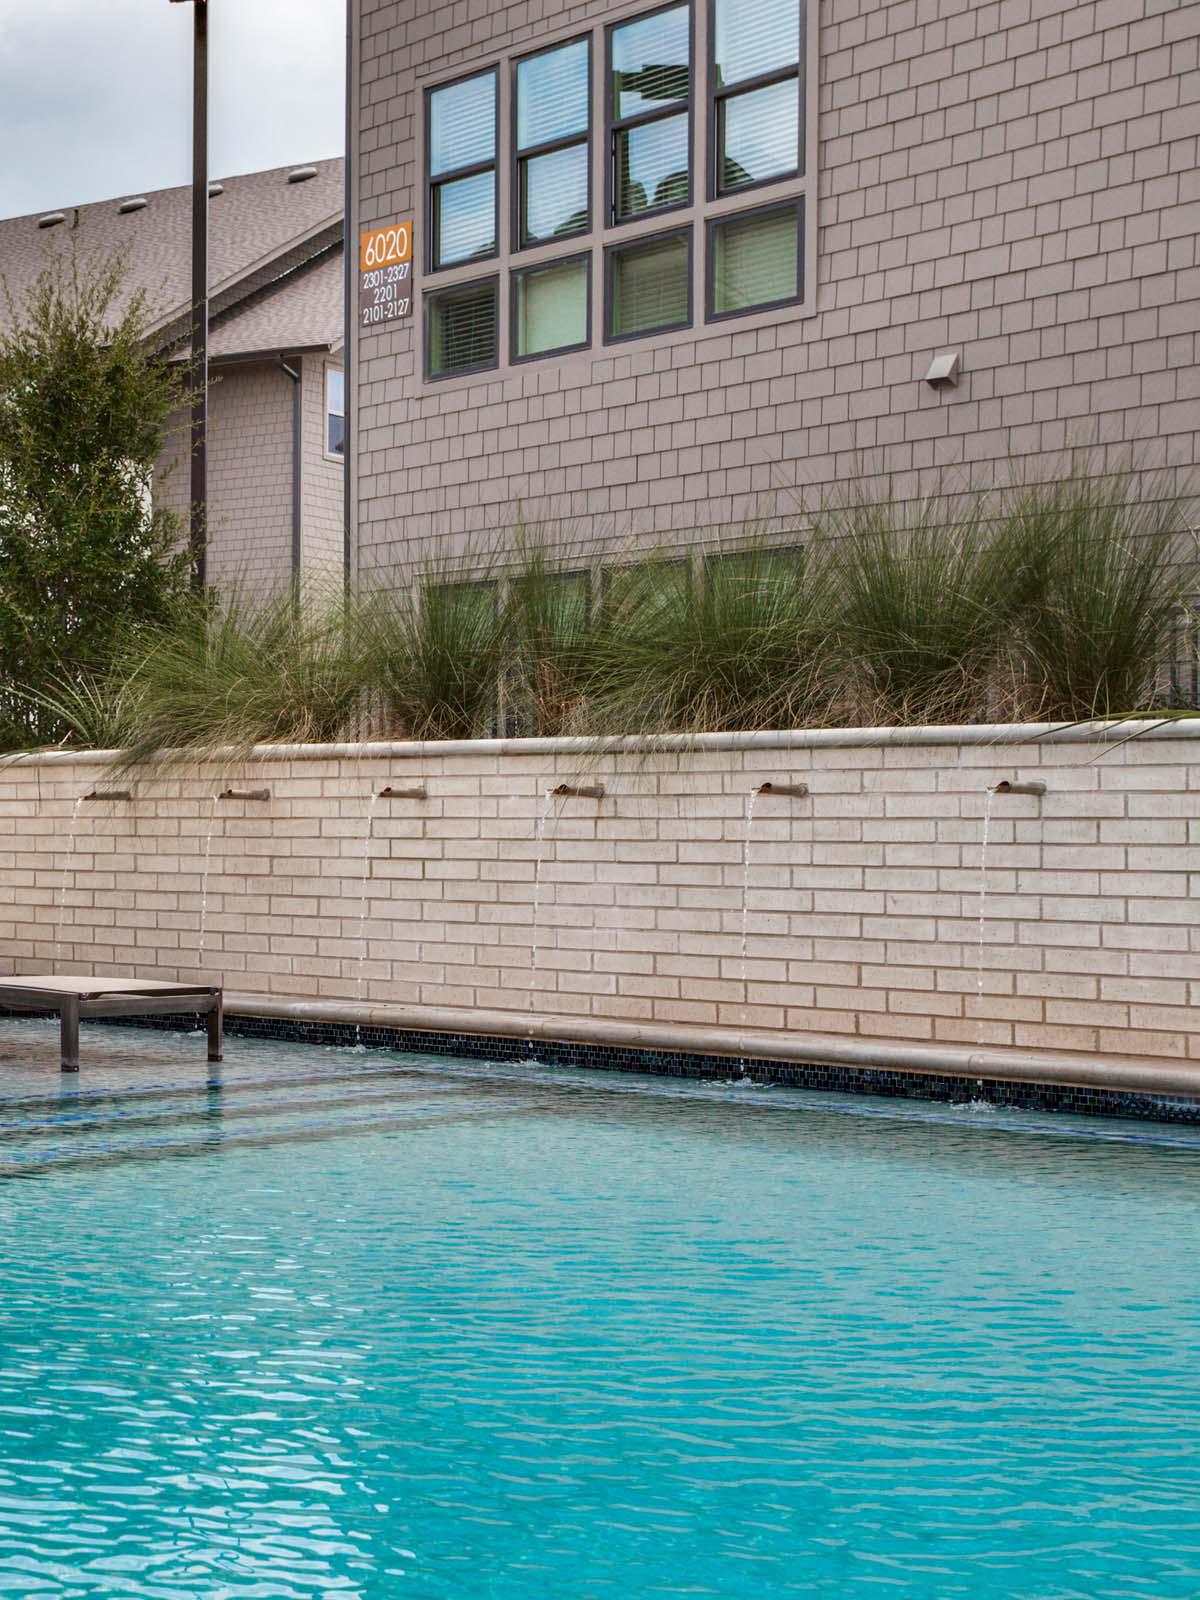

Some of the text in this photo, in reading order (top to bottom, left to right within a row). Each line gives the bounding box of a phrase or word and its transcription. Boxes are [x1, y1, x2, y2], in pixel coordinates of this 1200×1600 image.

[365, 227, 408, 266] 6020
[363, 263, 409, 288] 2301-2327
[374, 284, 397, 304] 2201
[363, 298, 409, 324] 2101-2127
